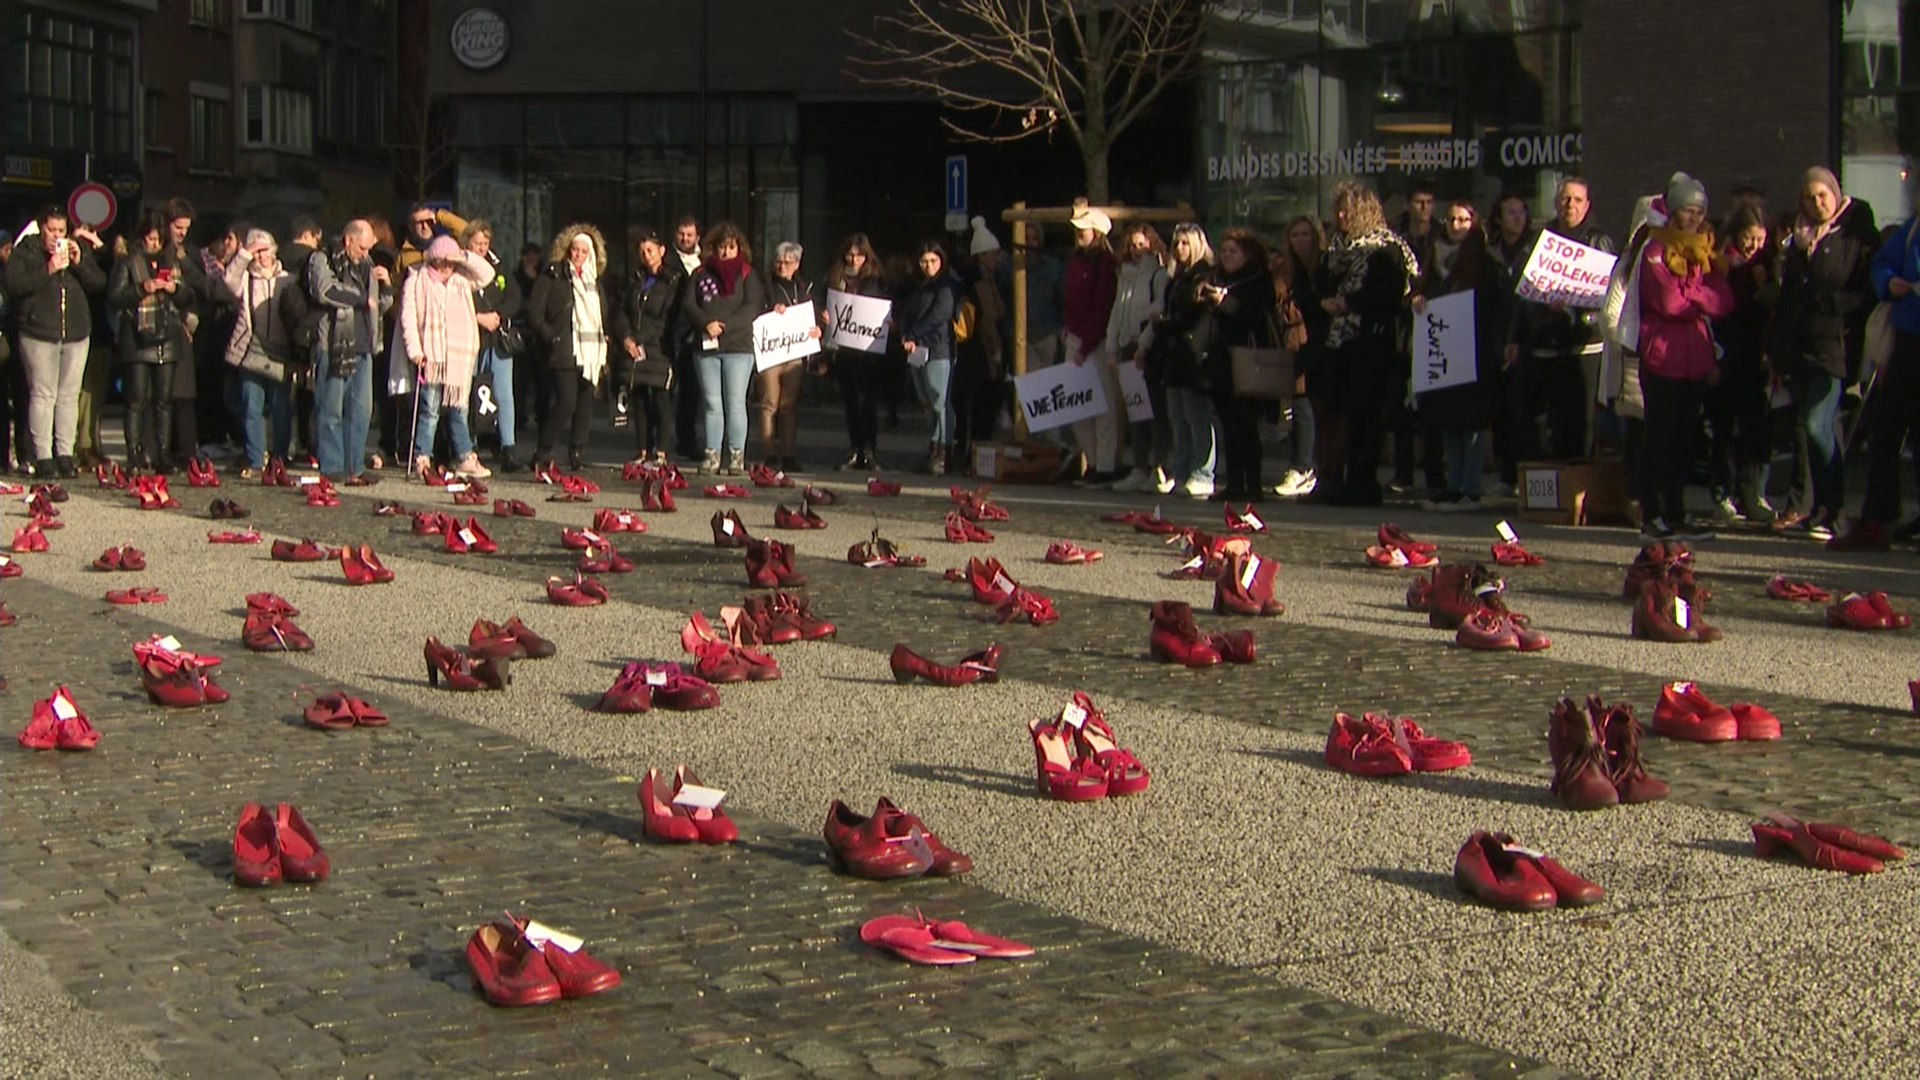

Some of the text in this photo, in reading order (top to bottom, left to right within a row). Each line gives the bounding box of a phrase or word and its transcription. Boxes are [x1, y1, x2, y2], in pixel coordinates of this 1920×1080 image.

[458, 31, 504, 49] KING
[1208, 152, 1281, 181] BANDES
[1284, 141, 1387, 177] DESSINÉES
[1400, 138, 1480, 174] MANGAS
[1543, 237, 1585, 261] STOP
[1529, 479, 1554, 497] 2018
